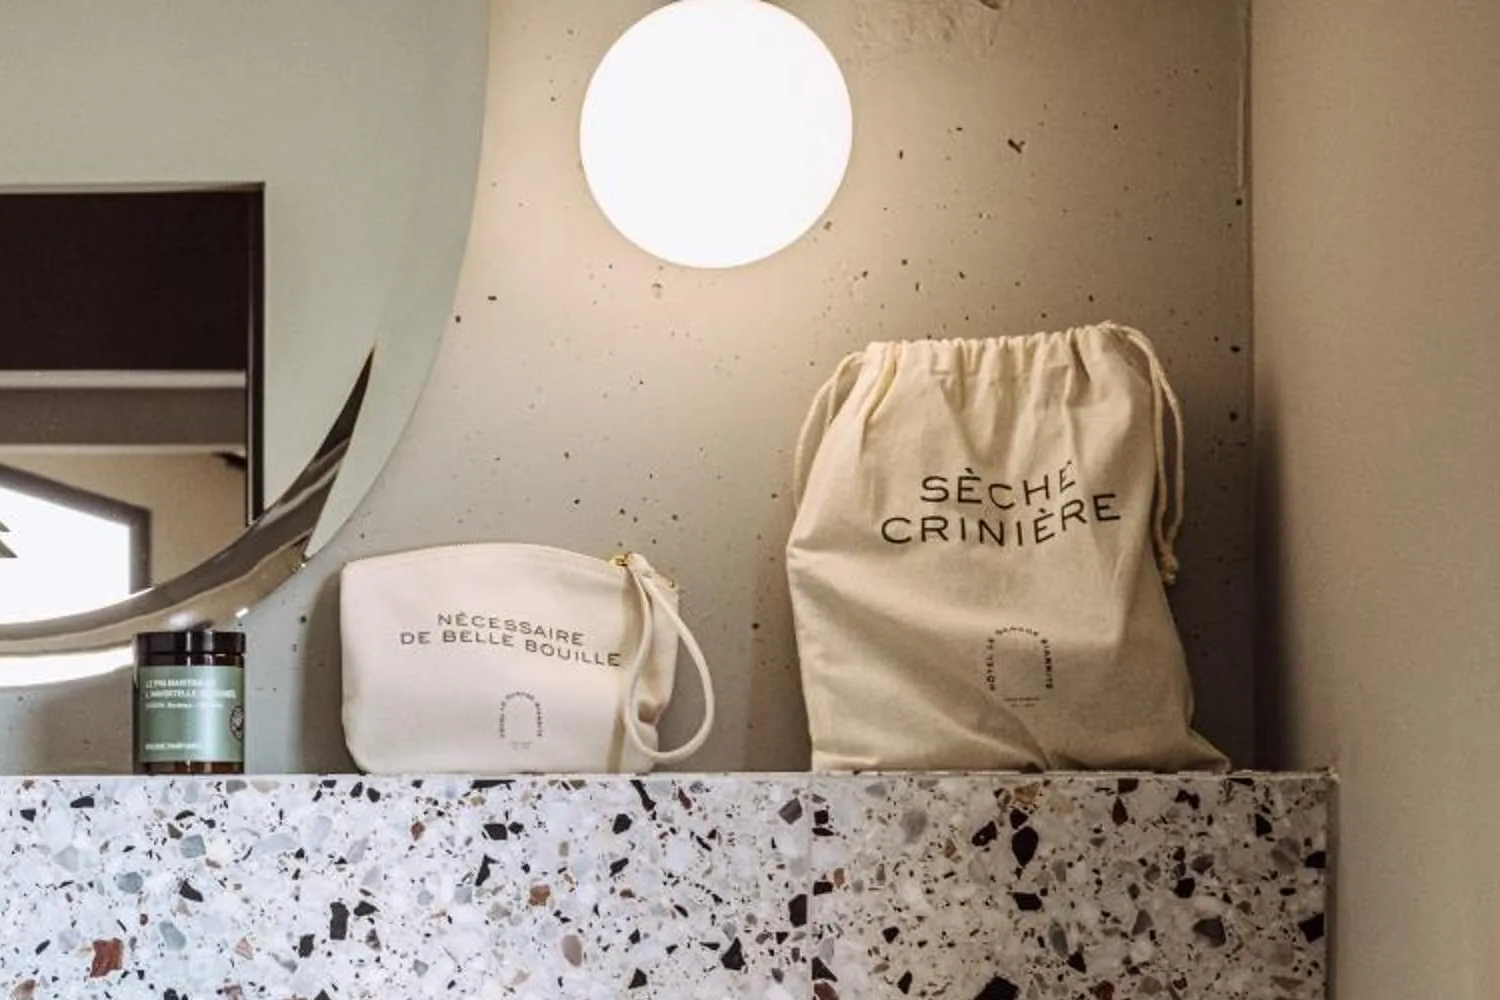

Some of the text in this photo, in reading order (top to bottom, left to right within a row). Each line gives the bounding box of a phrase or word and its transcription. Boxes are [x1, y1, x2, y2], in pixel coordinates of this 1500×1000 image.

[880, 492, 1122, 547] CRINIÈRE
[399, 629, 622, 668] DE BELLE BOUILLE
[436, 612, 586, 648] NÉCESSAIRE
